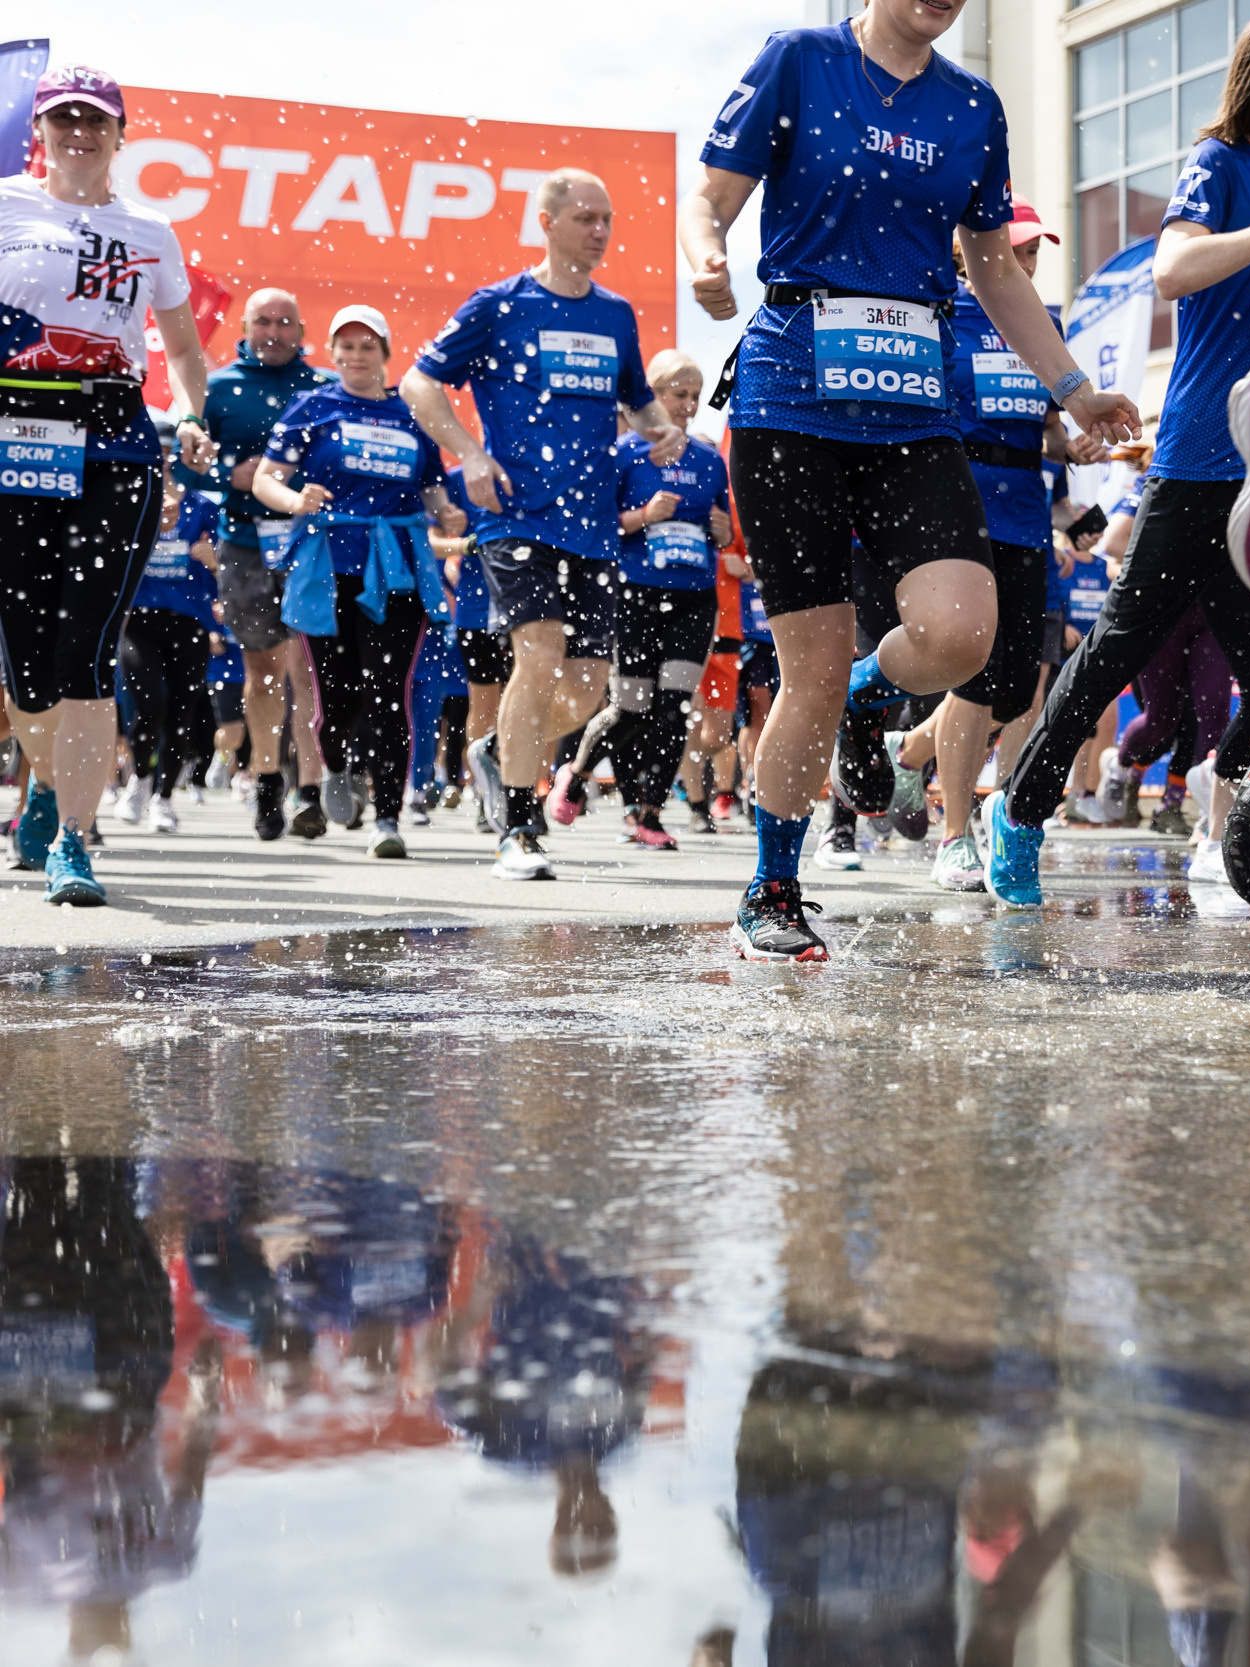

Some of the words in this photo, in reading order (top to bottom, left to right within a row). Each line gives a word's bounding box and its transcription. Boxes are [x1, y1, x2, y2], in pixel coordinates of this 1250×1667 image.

[57, 65, 98, 91] NY
[707, 128, 738, 149] 023
[549, 372, 612, 393] 50451
[824, 367, 942, 399] 50026
[981, 397, 1048, 416] 50830
[0, 469, 77, 491] 0058
